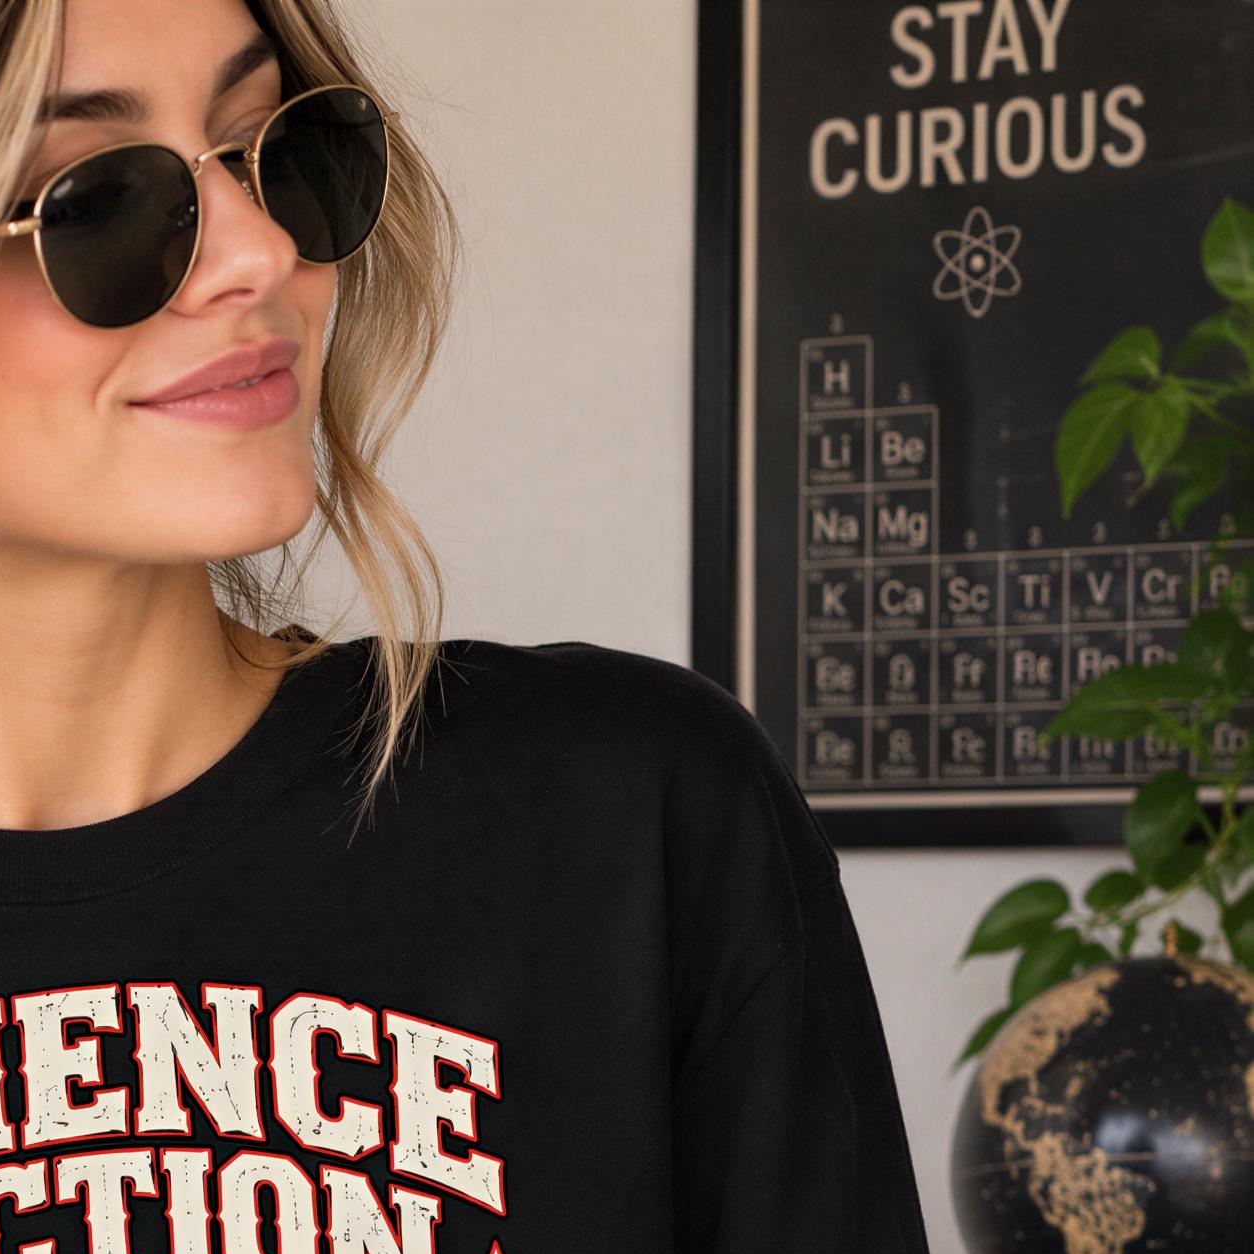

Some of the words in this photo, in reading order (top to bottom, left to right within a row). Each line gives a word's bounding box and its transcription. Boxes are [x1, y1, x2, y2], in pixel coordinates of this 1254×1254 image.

[889, 0, 1072, 88] STAY
[809, 84, 1146, 198] CURIOUS
[823, 360, 850, 395] H
[820, 433, 852, 469] Li
[880, 429, 926, 464] Be
[812, 509, 859, 544] Na
[878, 504, 928, 547] Mg
[821, 582, 847, 615] K
[879, 579, 925, 615] Ca
[947, 577, 990, 613] Sc
[1017, 574, 1051, 609] Ti
[1086, 570, 1113, 605] V
[1141, 567, 1182, 603] Cr
